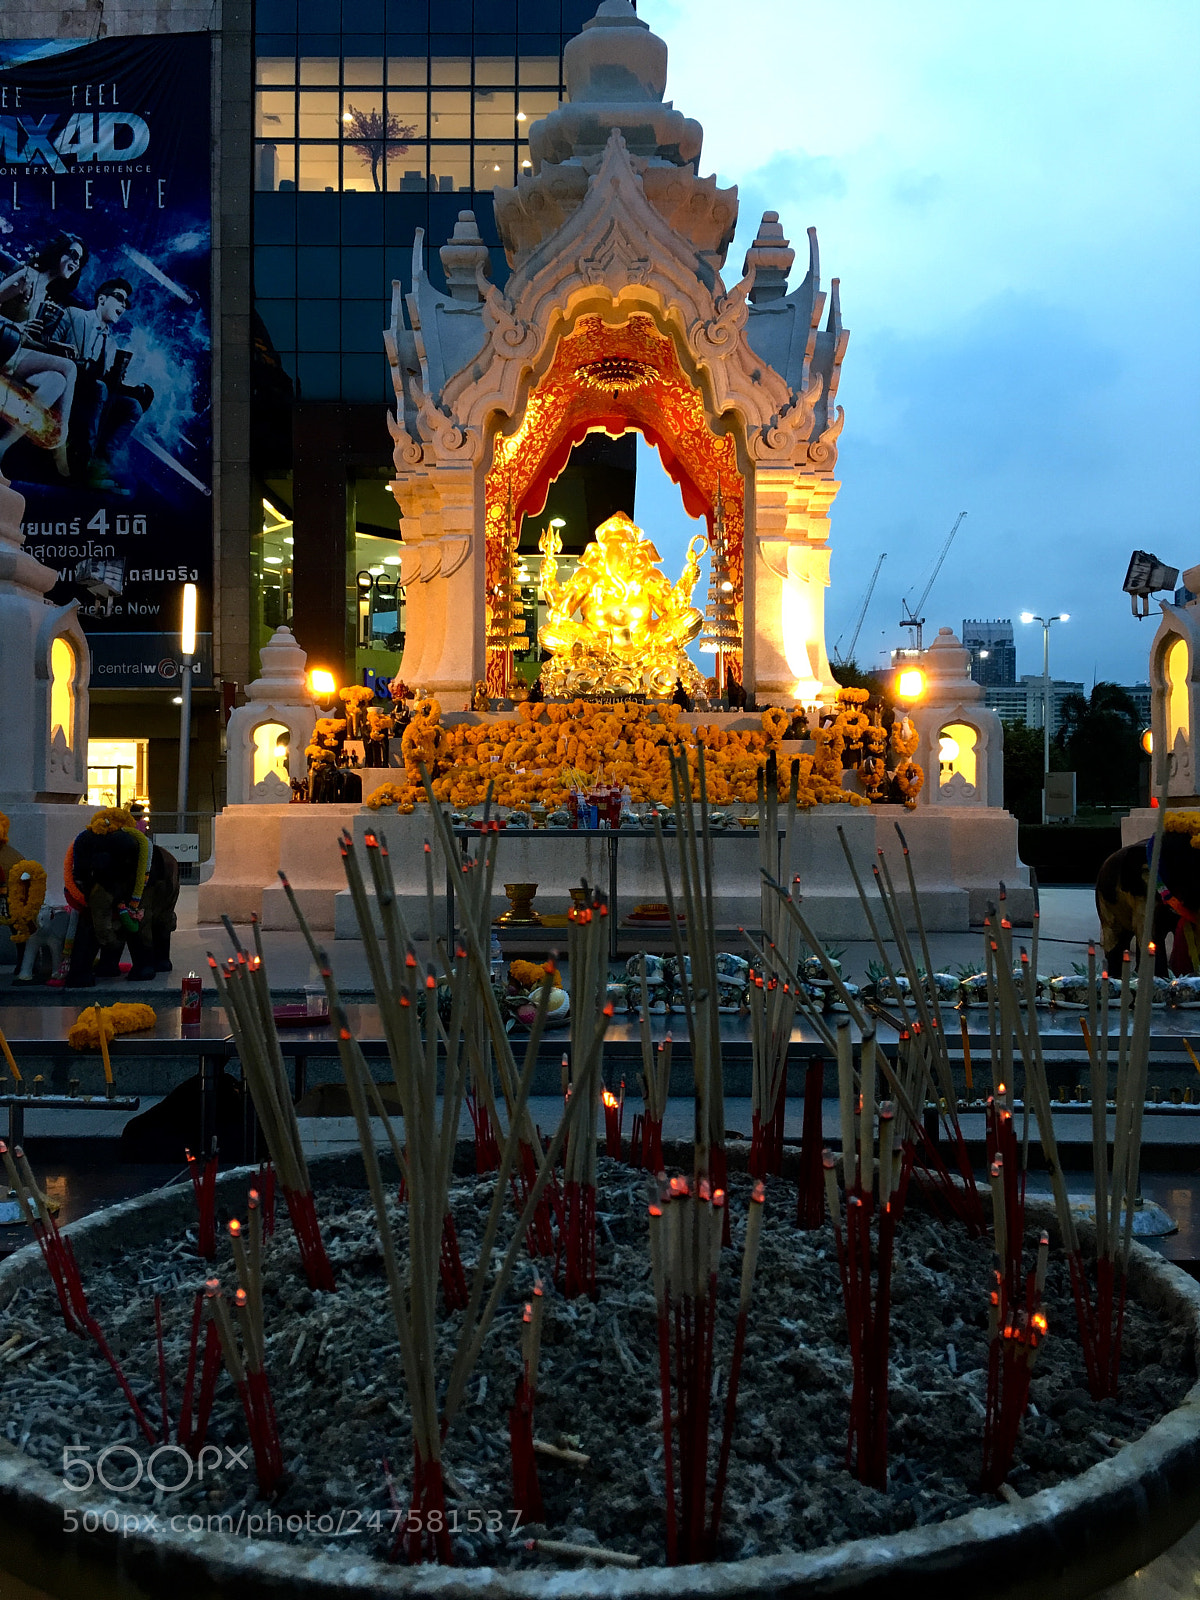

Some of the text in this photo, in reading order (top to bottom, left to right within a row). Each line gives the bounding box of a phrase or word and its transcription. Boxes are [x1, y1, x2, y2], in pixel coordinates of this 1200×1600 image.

[72, 83, 119, 106] FEEL
[70, 164, 152, 174] EXPERIENCE
[86, 508, 110, 535] 4
[116, 514, 147, 535] มิติ
[127, 602, 160, 615] Now
